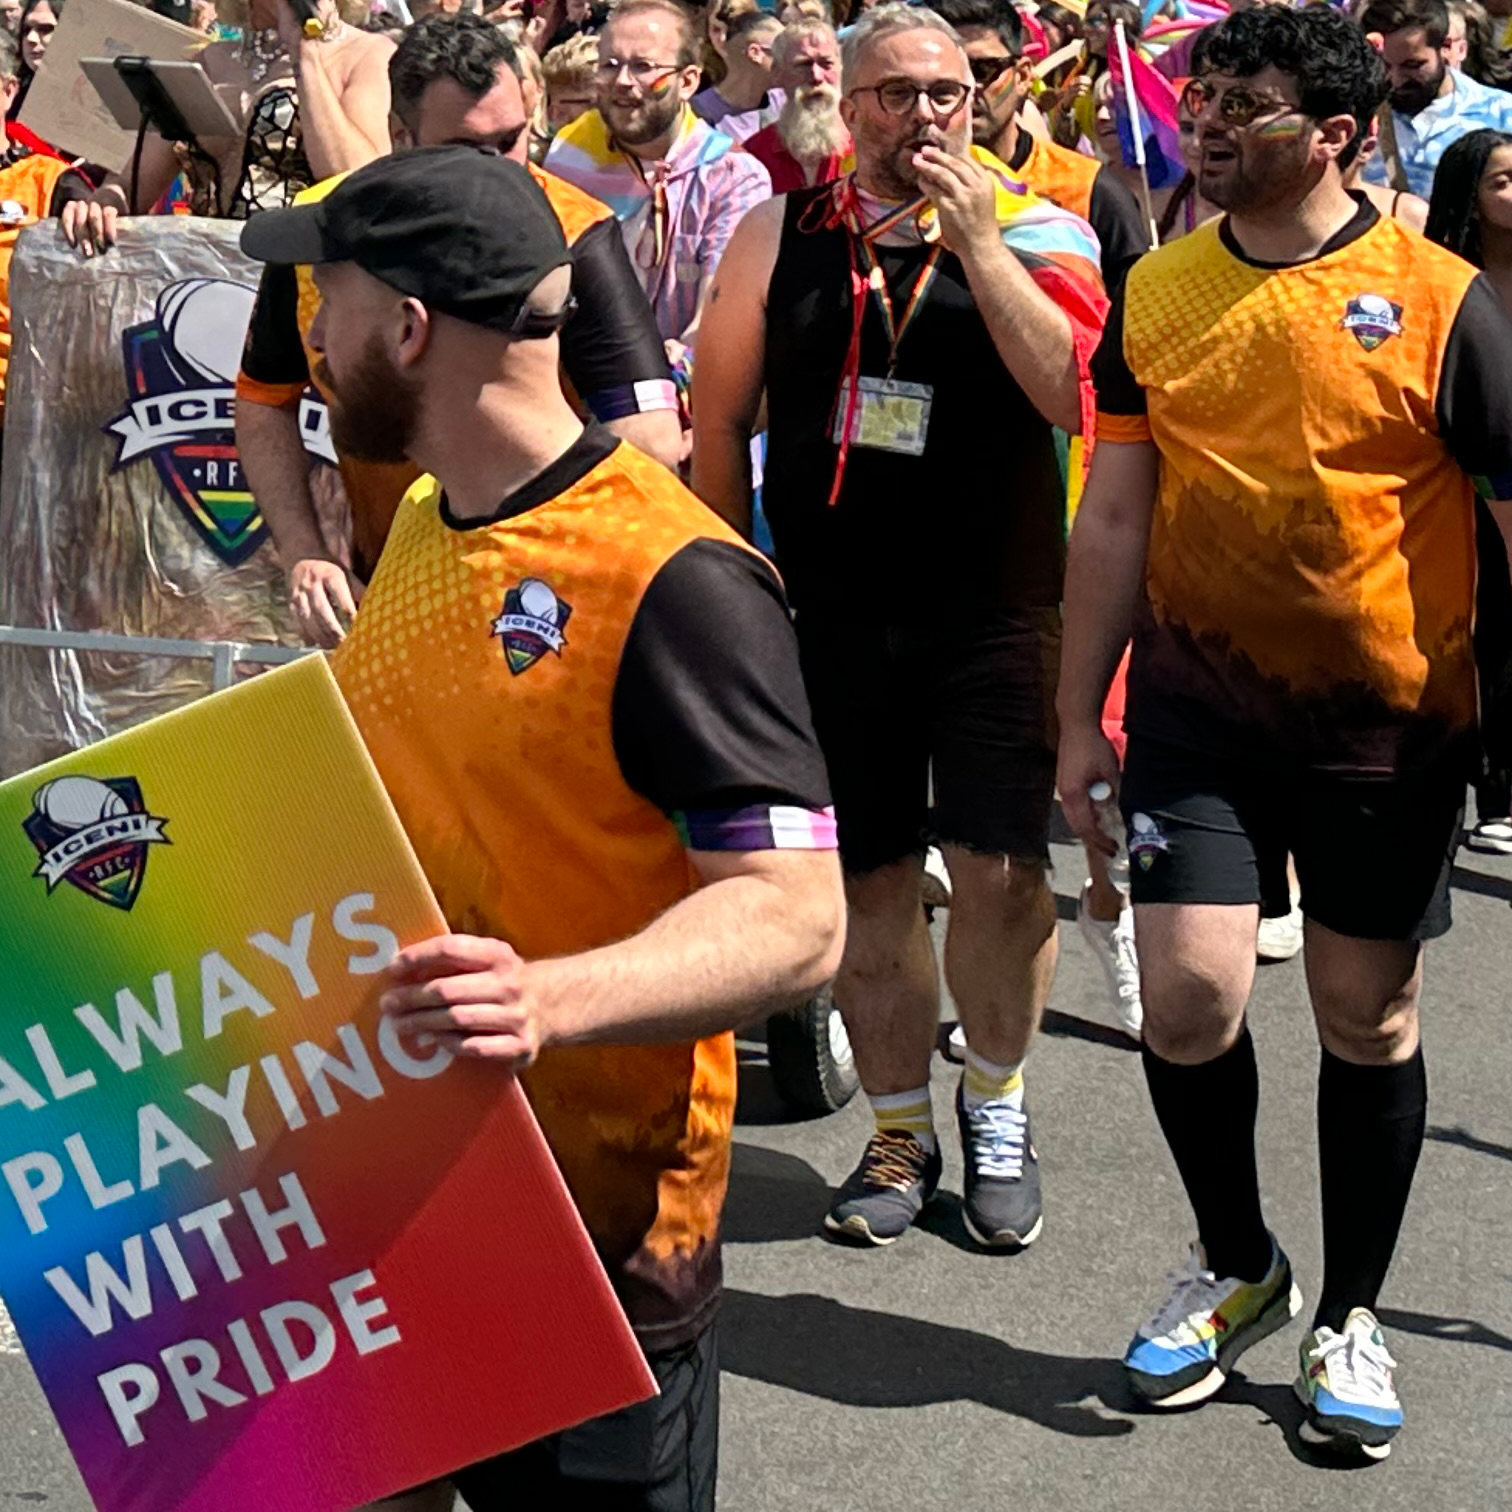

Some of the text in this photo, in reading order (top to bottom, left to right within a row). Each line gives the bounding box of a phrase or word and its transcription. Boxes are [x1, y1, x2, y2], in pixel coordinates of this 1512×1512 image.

[145, 398, 323, 432] ICEI
[51, 817, 142, 864] ICENI
[0, 1023, 454, 1236] PLAYING
[43, 1171, 328, 1337] WITH
[96, 1268, 402, 1448] PRIDE
